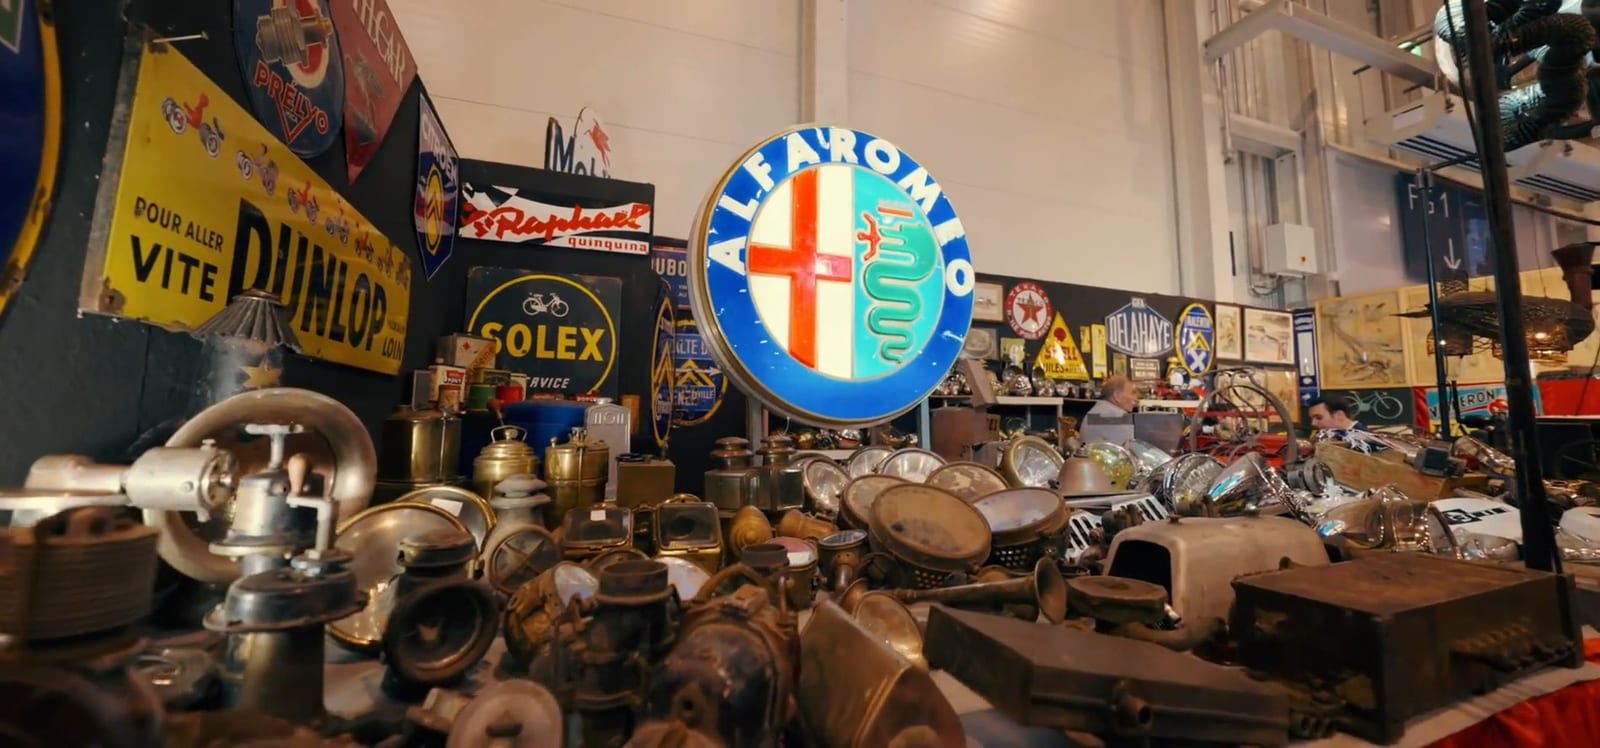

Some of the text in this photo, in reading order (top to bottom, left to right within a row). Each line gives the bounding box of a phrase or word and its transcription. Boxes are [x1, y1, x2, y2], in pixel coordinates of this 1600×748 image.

[134, 196, 224, 254] POUR ALLER
[707, 131, 821, 277] ALFA
[568, 236, 648, 253] quinquina
[130, 234, 218, 303] VITE
[226, 197, 388, 351] DUNLOP
[382, 336, 402, 361] LOIN
[480, 321, 605, 362] SOLEX
[1043, 345, 1078, 360] SELL
[1108, 311, 1171, 355] DELAHAYE
[526, 375, 570, 390] RVICE
